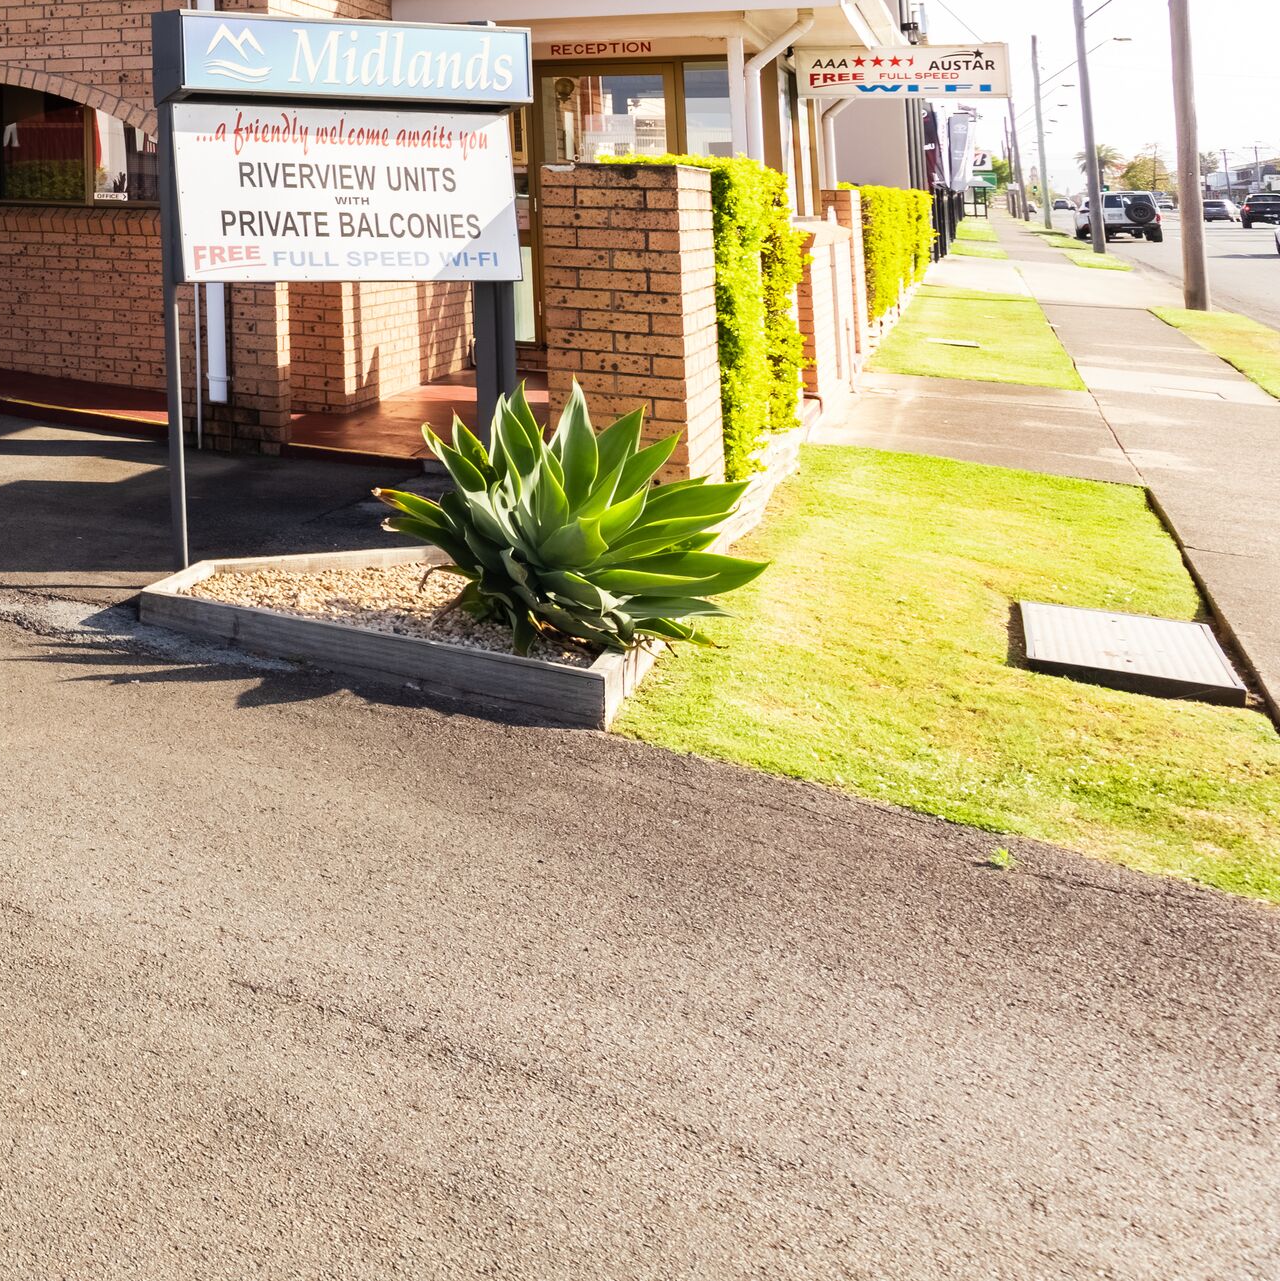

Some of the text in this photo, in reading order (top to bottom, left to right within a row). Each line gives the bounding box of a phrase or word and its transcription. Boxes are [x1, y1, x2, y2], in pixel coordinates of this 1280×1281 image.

[551, 41, 652, 56] RECEPTION
[288, 28, 513, 92] Midlands
[811, 58, 996, 71] AAA AUSTAR
[809, 72, 865, 87] FREE
[915, 72, 960, 80] SPEED
[856, 84, 992, 93] WI-FI
[233, 111, 309, 156] friendly
[316, 118, 390, 147] welcome
[396, 125, 453, 149] awaits
[459, 128, 488, 161] you
[239, 161, 457, 193] RIVERVIEW UNITS
[335, 196, 370, 206] WITH
[221, 210, 482, 240] PRIVATE BALCONIES
[193, 245, 499, 271] FREE FULL SPEED WI-FI
